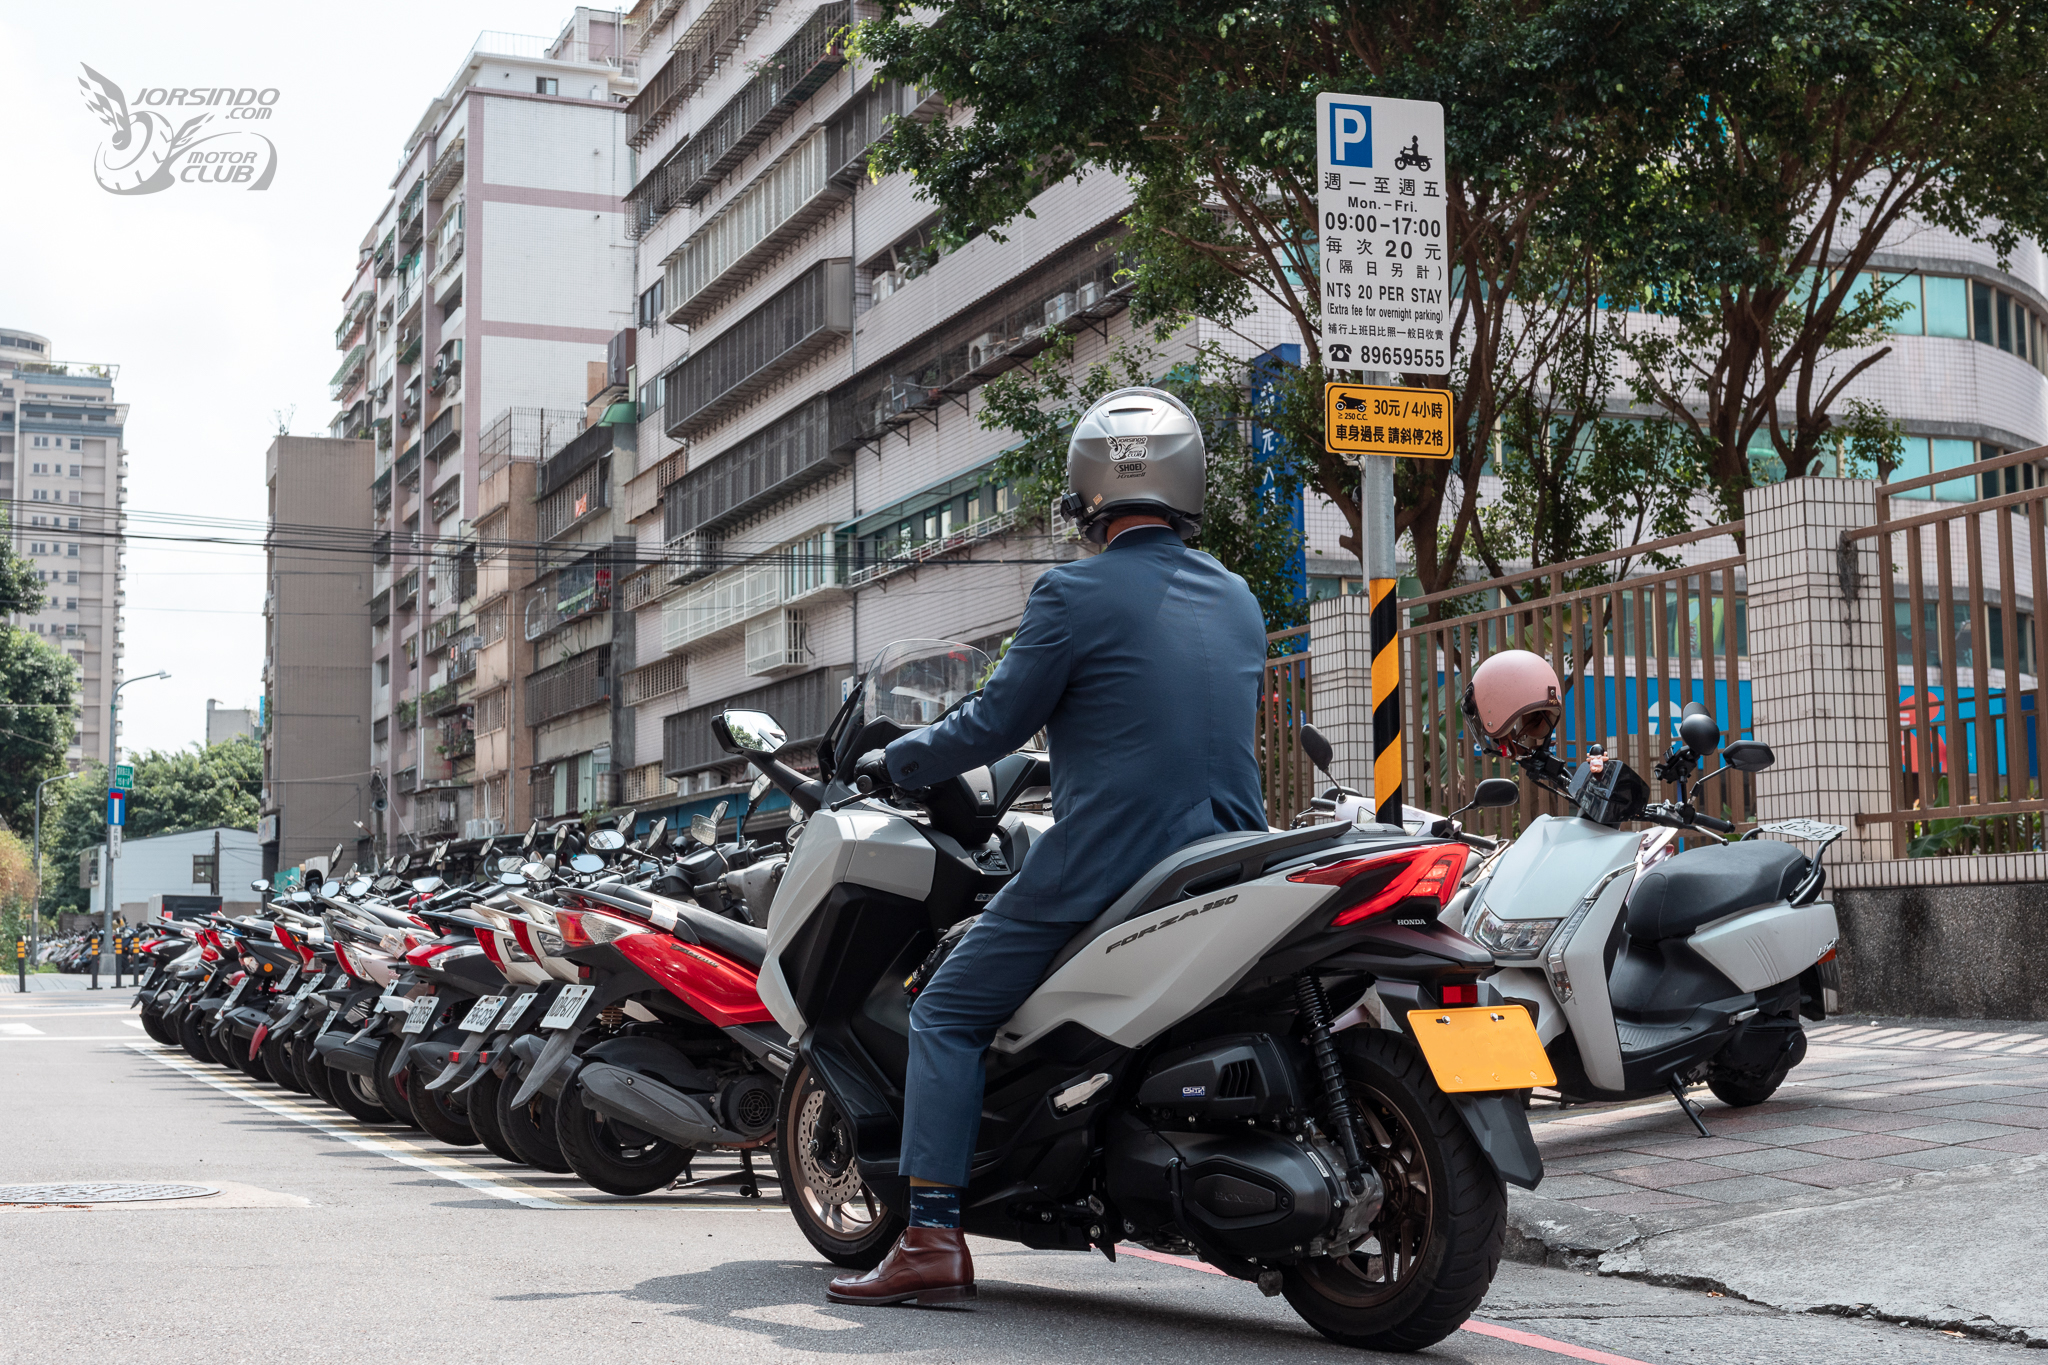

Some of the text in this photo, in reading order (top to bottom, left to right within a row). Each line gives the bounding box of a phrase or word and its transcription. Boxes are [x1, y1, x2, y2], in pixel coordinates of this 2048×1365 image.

[1334, 107, 1367, 161] P
[1324, 171, 1440, 198] 週一至週五
[1326, 282, 1442, 304] NT$ 20 PER STAY
[1327, 302, 1443, 324] (Extra fee for overnight parking)
[1328, 322, 1444, 341] 補行上班日比照一般日收費
[1360, 345, 1445, 368] 89659555
[1344, 412, 1356, 420] 250
[1373, 399, 1400, 417] 30元
[1411, 401, 1443, 419] 4小時
[1335, 424, 1444, 447] 車身過長 請斜停2格
[1119, 463, 1142, 472] SHOEI
[1396, 918, 1427, 926] HONDA
